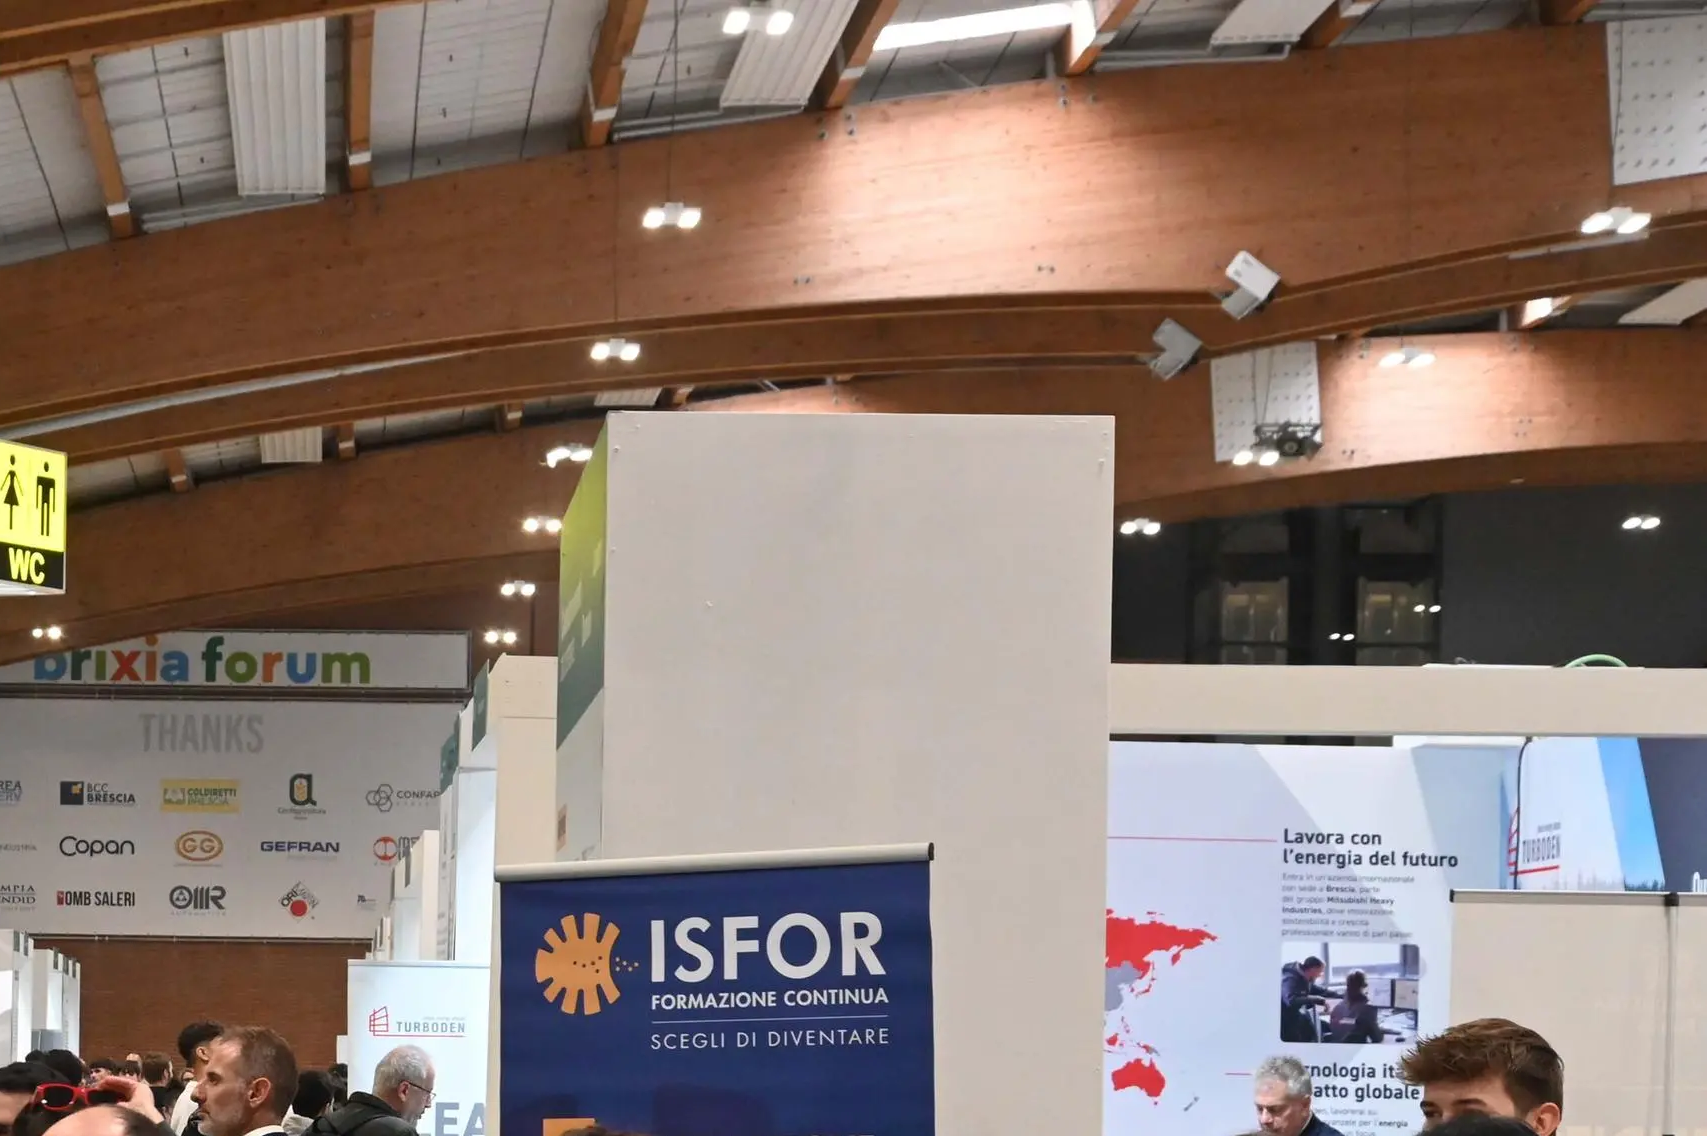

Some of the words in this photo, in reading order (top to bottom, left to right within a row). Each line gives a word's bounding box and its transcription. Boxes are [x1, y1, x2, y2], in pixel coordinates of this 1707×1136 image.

[8, 547, 45, 585] WC
[33, 636, 189, 682] brixia
[201, 636, 371, 684] forum
[140, 713, 264, 754] THANKS
[87, 783, 108, 792] BCC
[187, 788, 237, 797] COLDIRETTI
[396, 790, 440, 799] CONFAP
[87, 793, 136, 804] BRESCIA
[59, 835, 135, 857] Copan
[1283, 828, 1344, 845] Lavora
[1351, 833, 1382, 845] con
[260, 841, 340, 853] GEFRAN
[1522, 836, 1561, 864] TURBODEN
[1283, 848, 1363, 869] l'energia
[1369, 850, 1395, 866] del
[1402, 851, 1459, 867] futuro
[94, 891, 135, 906] SALERI
[651, 912, 886, 983] ISFOR
[651, 991, 777, 1010] FORMAZIONE
[783, 987, 889, 1006] CONTINUA
[396, 1021, 465, 1033] TURBODEN
[651, 1034, 726, 1050] SCEGLI
[736, 1032, 757, 1048] DI
[768, 1028, 889, 1048] DIVENTARE
[1305, 1062, 1376, 1082] nologia
[1313, 1084, 1349, 1098] atto
[1355, 1083, 1420, 1102] globale
